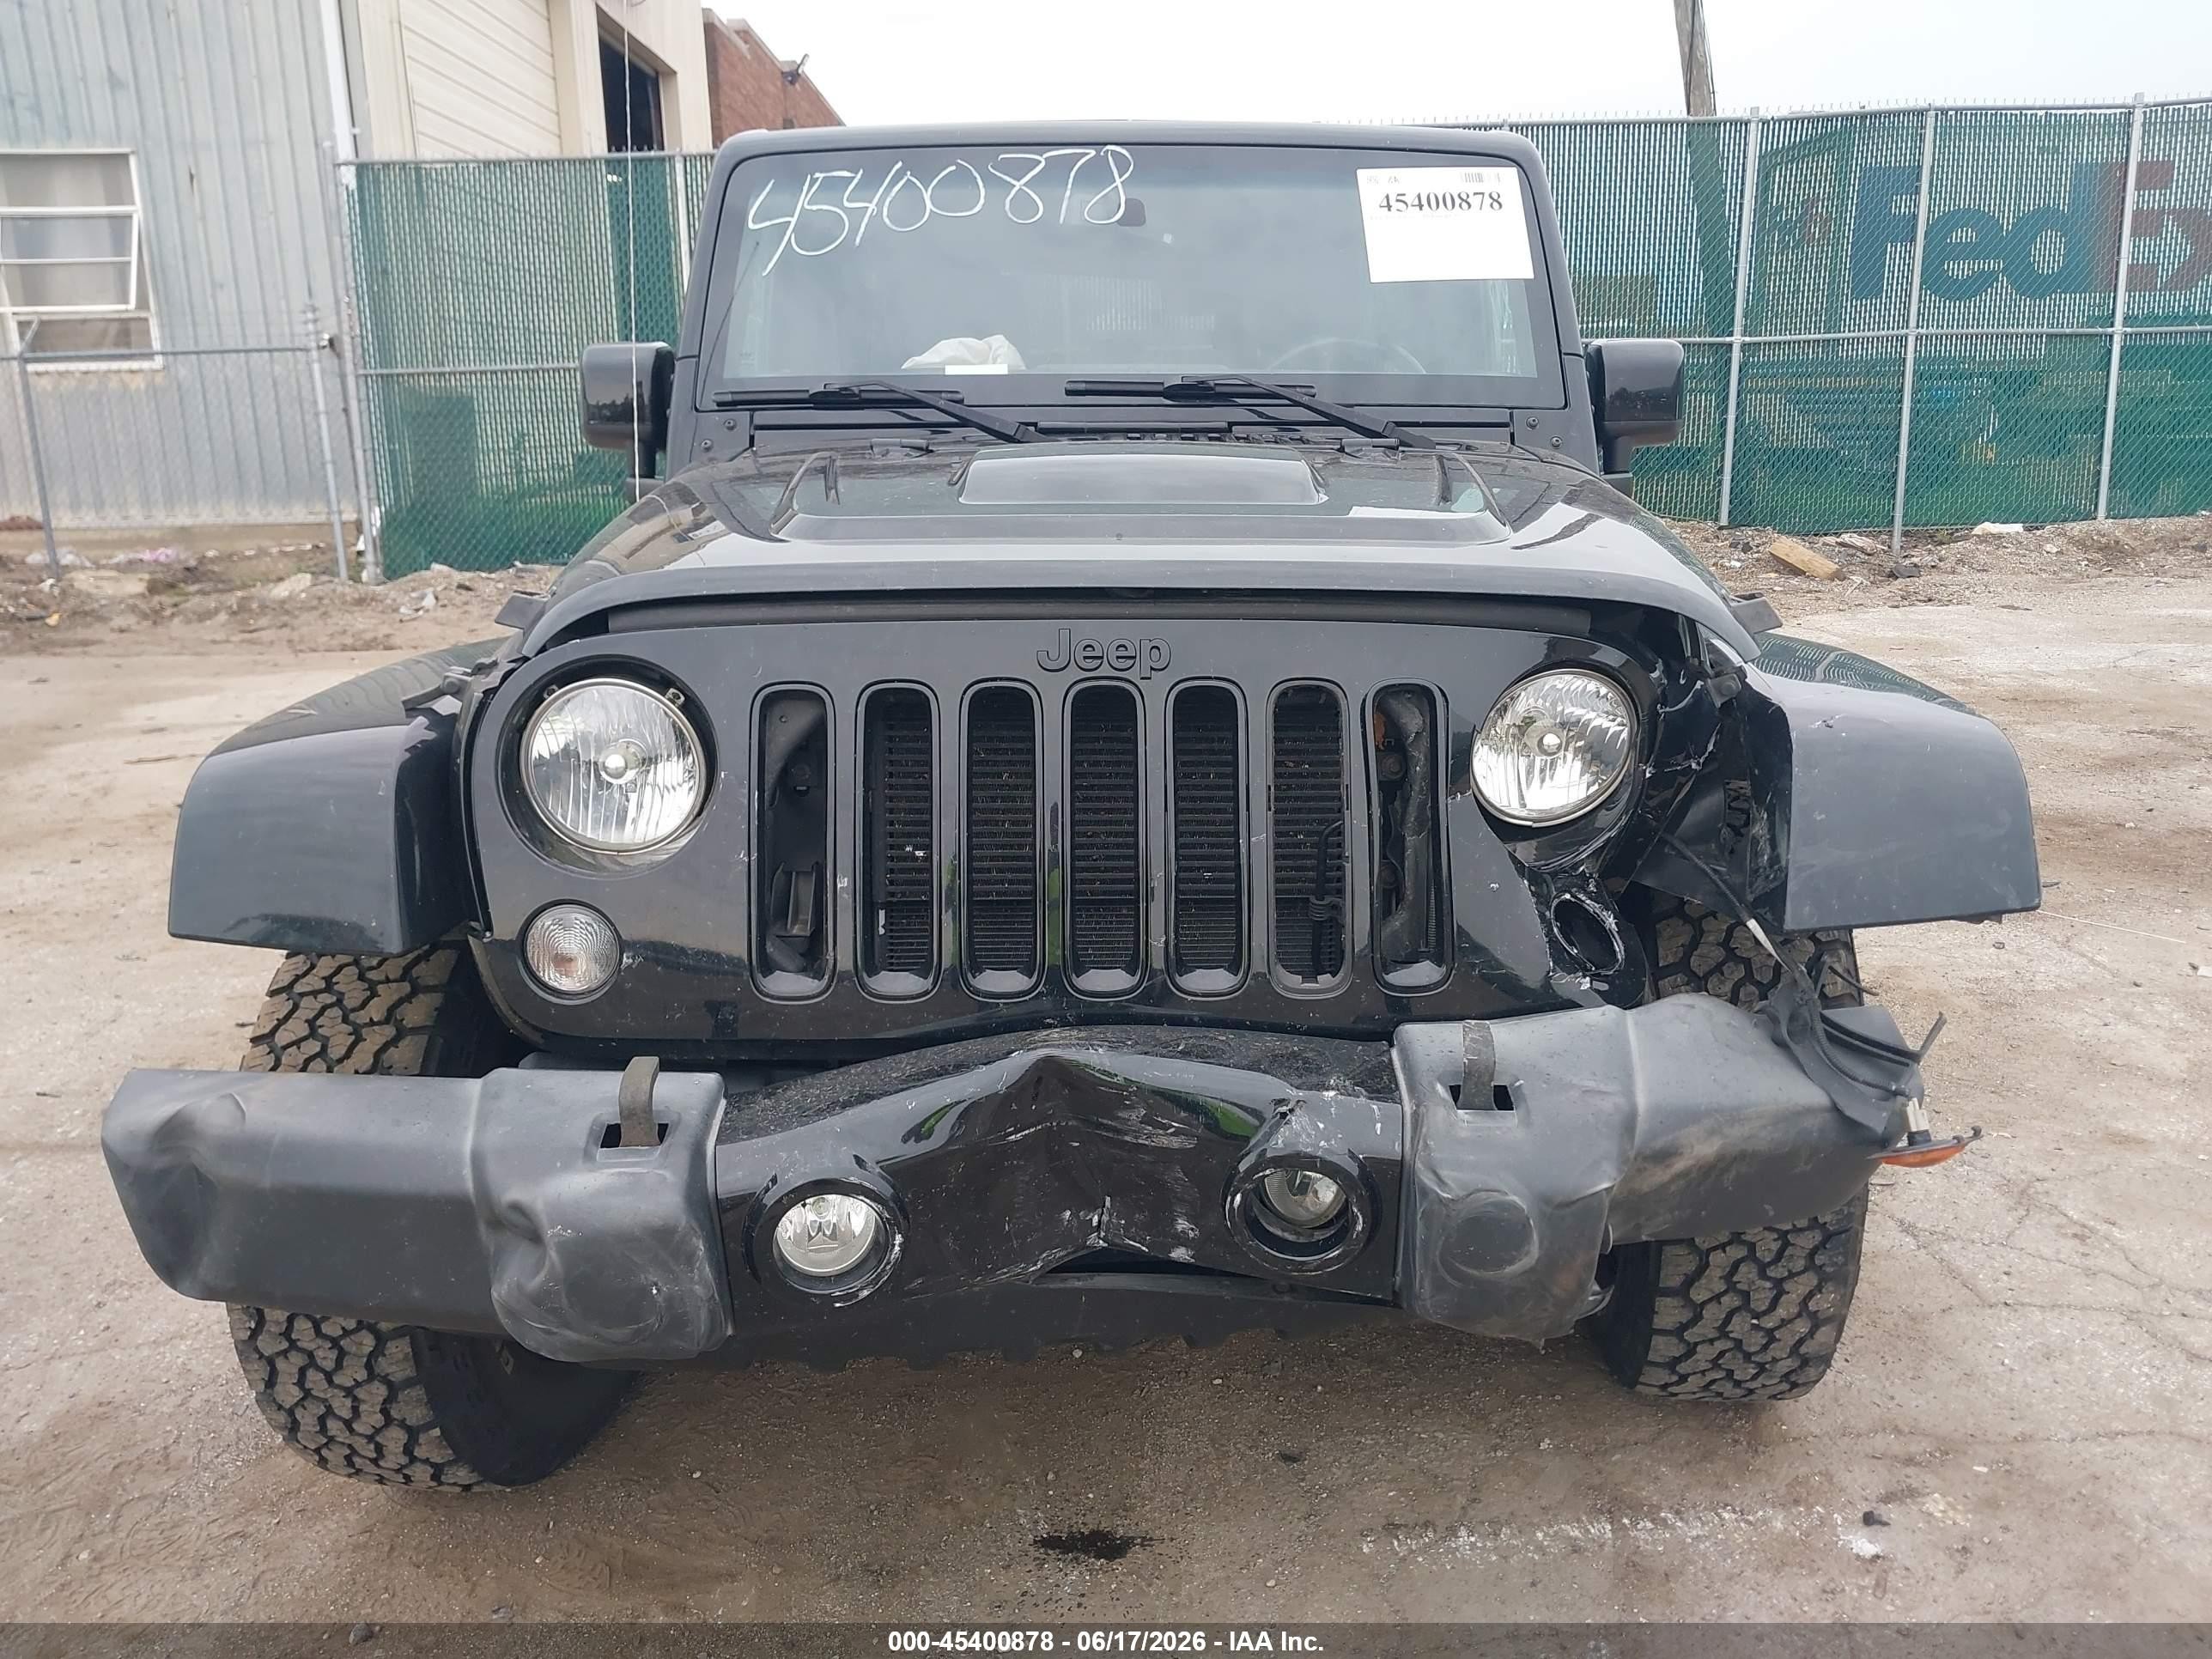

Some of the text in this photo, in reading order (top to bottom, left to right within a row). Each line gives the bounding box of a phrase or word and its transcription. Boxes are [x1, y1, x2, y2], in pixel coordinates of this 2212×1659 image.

[747, 144, 1134, 276] 45400878
[1379, 191, 1504, 212] 45400878
[1036, 628, 1171, 680] Jeep
